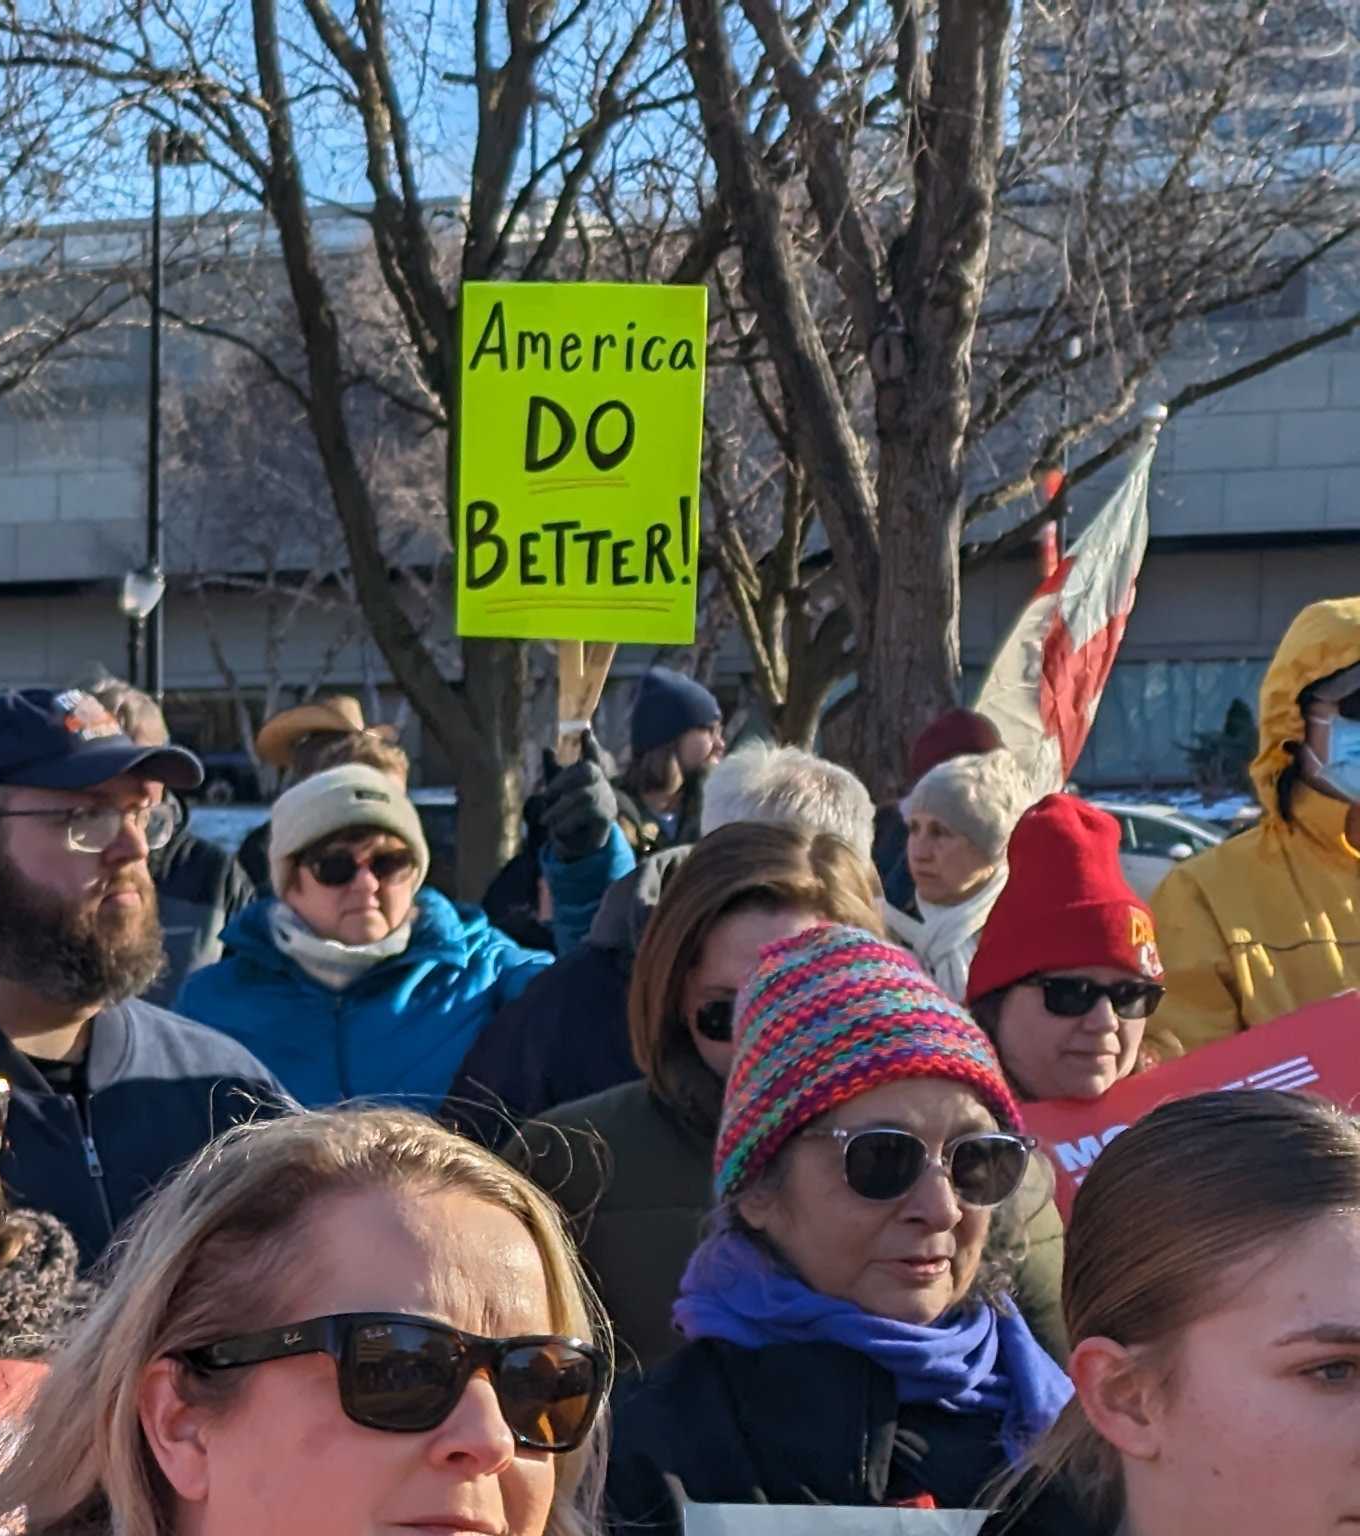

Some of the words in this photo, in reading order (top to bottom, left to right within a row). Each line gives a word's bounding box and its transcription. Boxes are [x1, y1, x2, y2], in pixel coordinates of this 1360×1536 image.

[468, 301, 696, 372] America
[524, 395, 635, 473] DO
[465, 496, 691, 590] BETTER!
